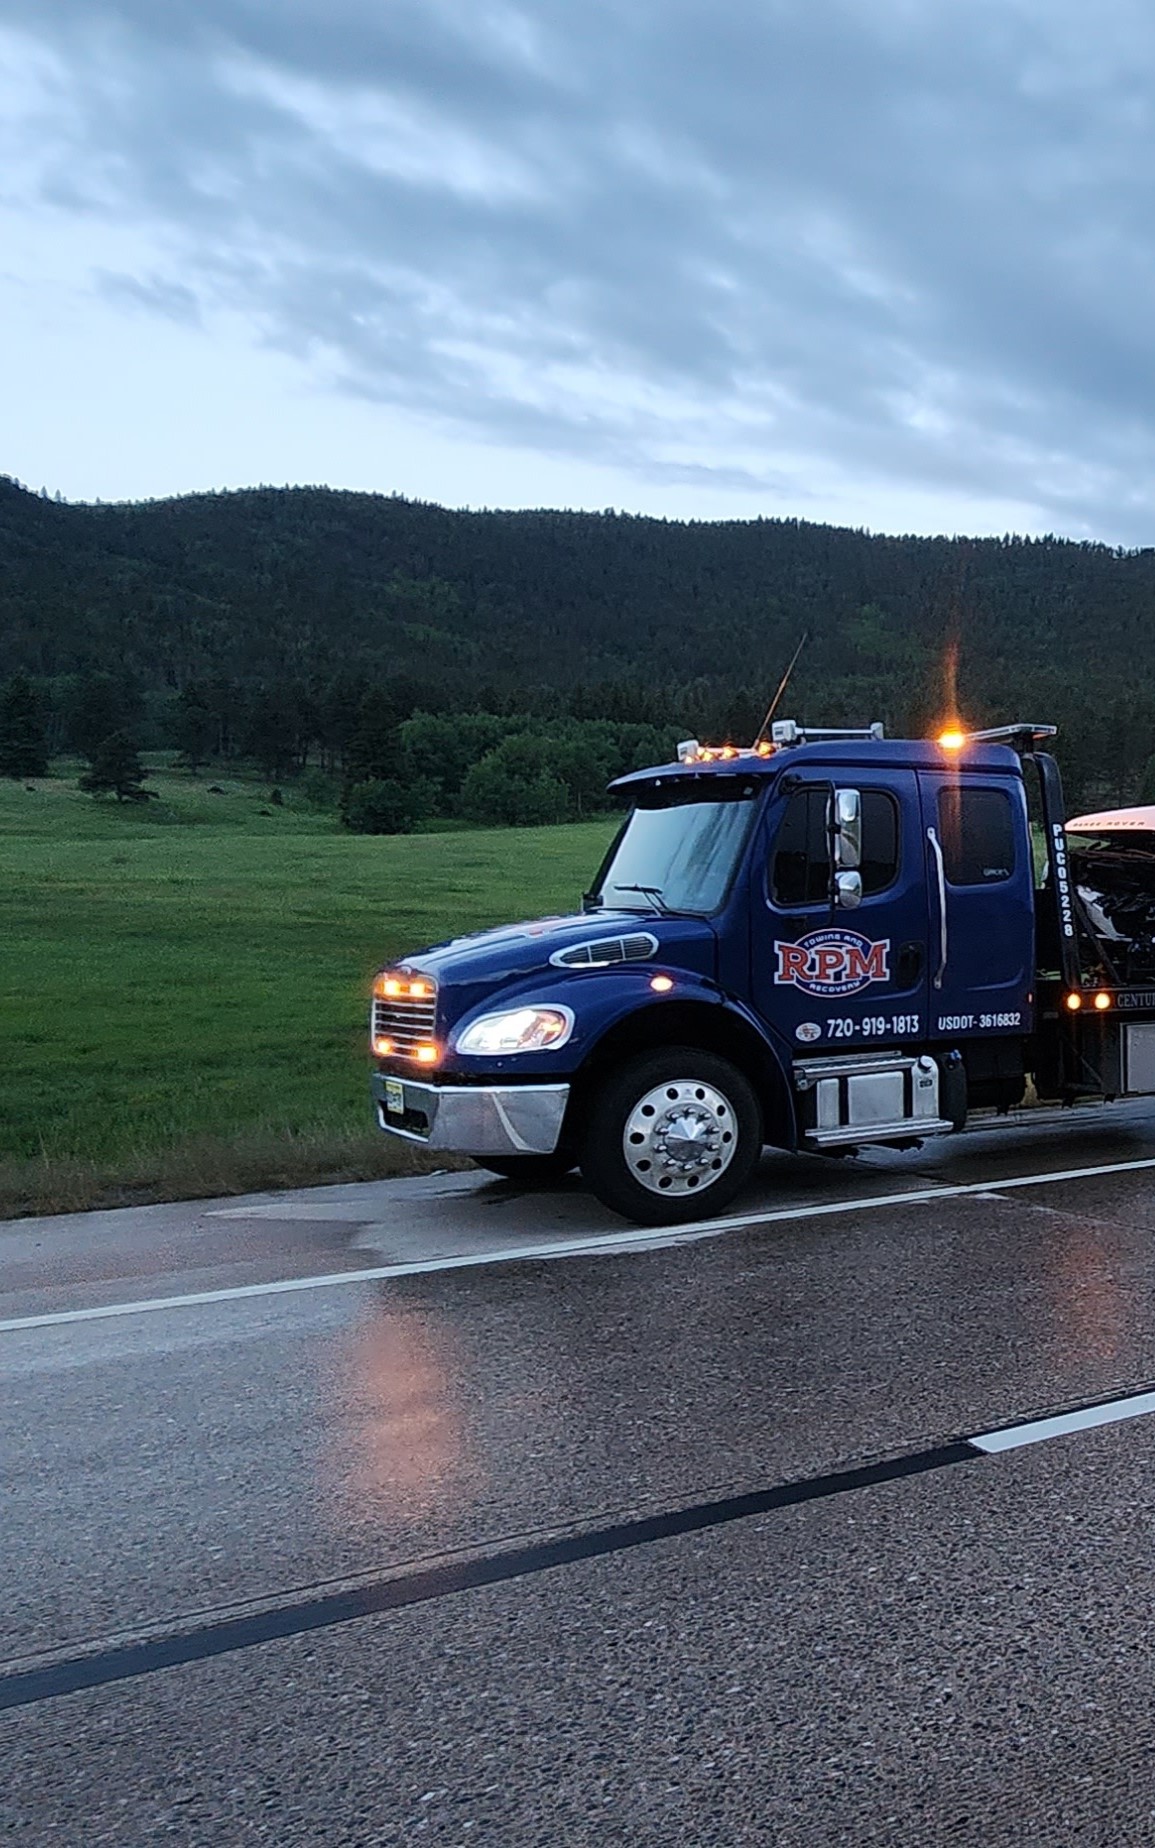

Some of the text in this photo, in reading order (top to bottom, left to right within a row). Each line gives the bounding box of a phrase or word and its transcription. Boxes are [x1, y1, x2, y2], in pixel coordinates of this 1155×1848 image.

[803, 933, 864, 948] TOWING AND
[775, 940, 889, 983] RPM
[809, 980, 861, 993] RECOVERY
[826, 1014, 920, 1038] 720-919-1813
